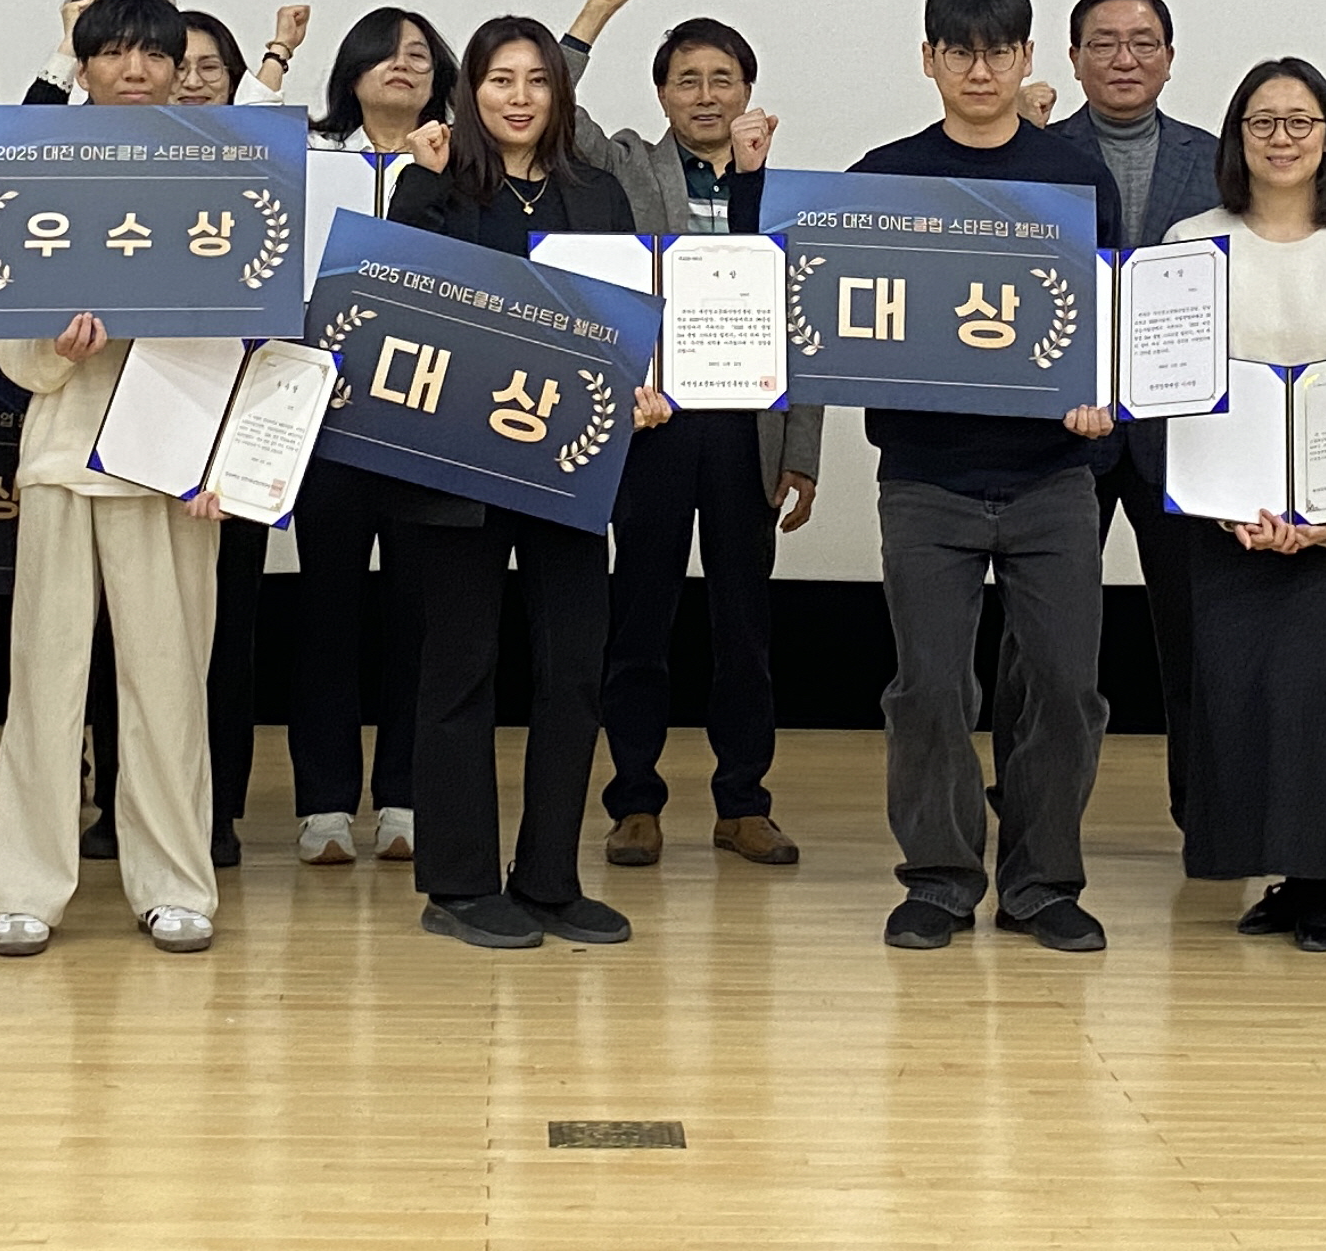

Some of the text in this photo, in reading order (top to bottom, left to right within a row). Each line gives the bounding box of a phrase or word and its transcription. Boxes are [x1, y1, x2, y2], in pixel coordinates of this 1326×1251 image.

[43, 146, 74, 160] 대전
[80, 145, 147, 160] ONE클럽
[153, 146, 215, 160] 스타트업
[798, 211, 837, 227] 2025
[843, 213, 872, 229] 대전
[878, 215, 942, 233] ONE클럽
[949, 219, 1008, 236] 스타트업
[358, 260, 400, 283] 2025
[404, 272, 435, 293] 대전
[438, 281, 504, 313] ONE클럽
[506, 301, 570, 331] 스타트업
